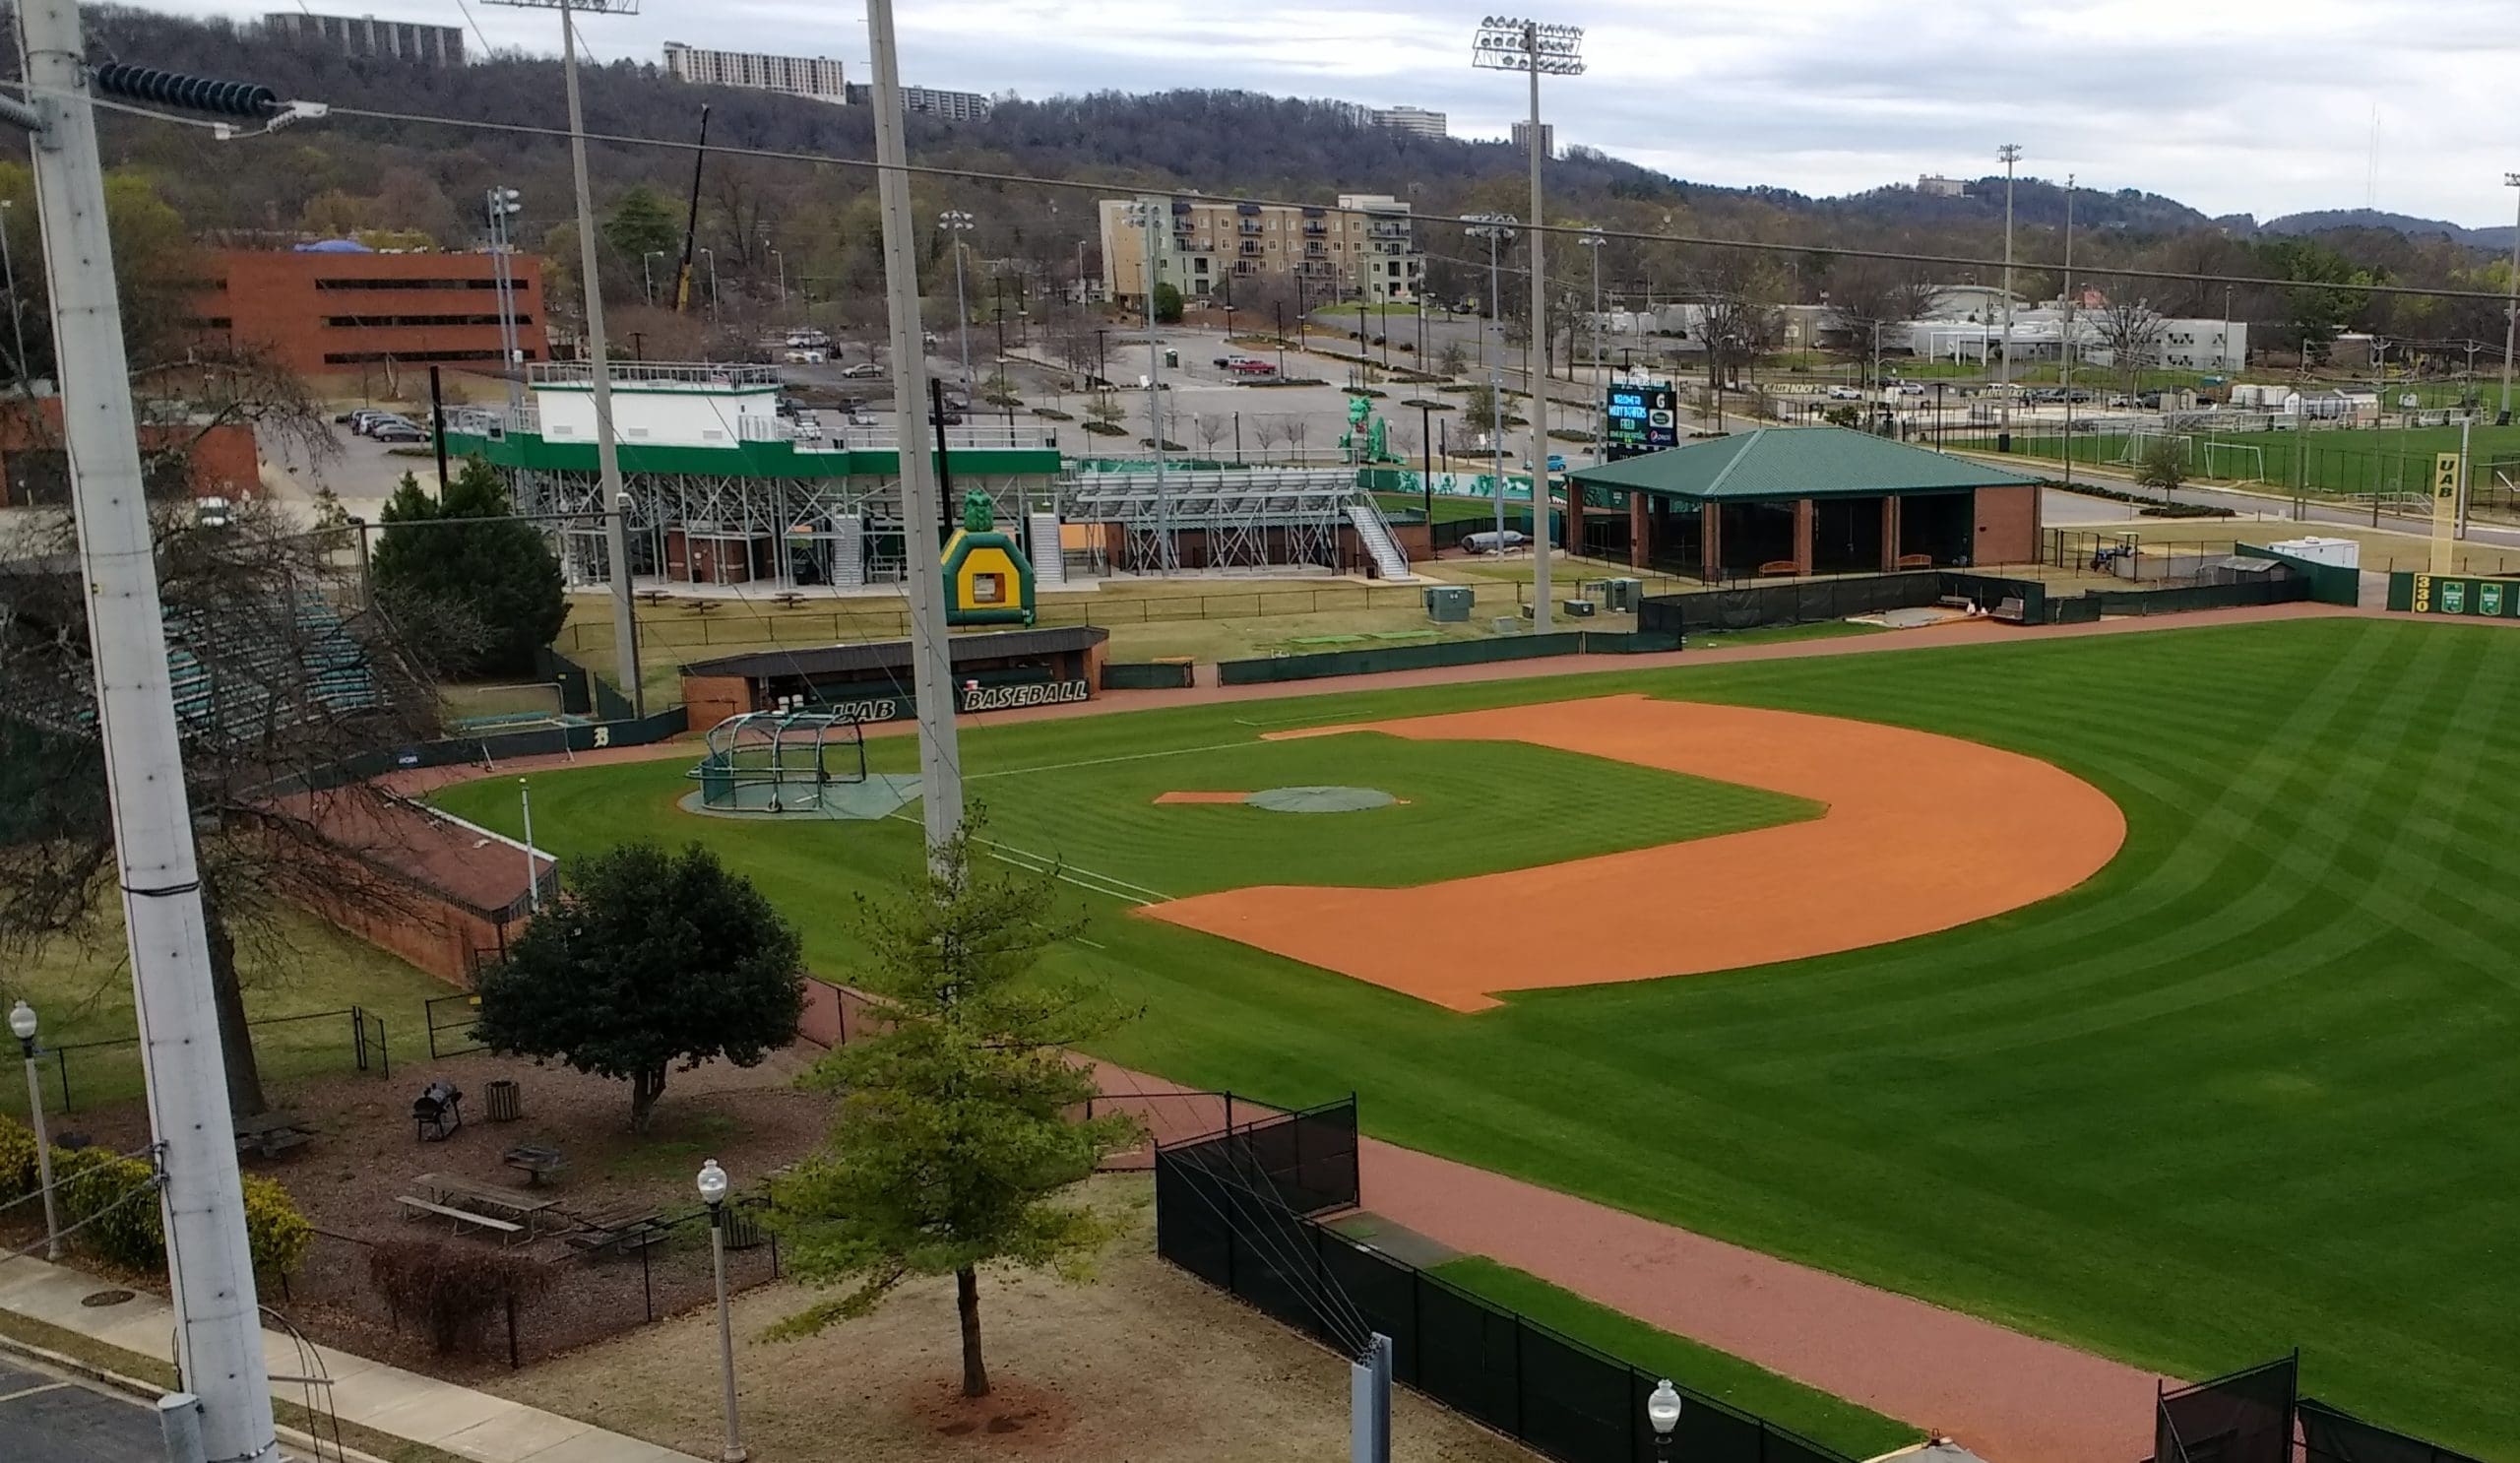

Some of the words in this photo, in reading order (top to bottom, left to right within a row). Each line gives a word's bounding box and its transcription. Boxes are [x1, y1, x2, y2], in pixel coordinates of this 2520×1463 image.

[1656, 393, 1666, 409] G
[2438, 460, 2455, 498] UAB
[2416, 576, 2430, 612] 330
[964, 680, 1088, 711] BASEBALL
[832, 699, 896, 724] UAB
